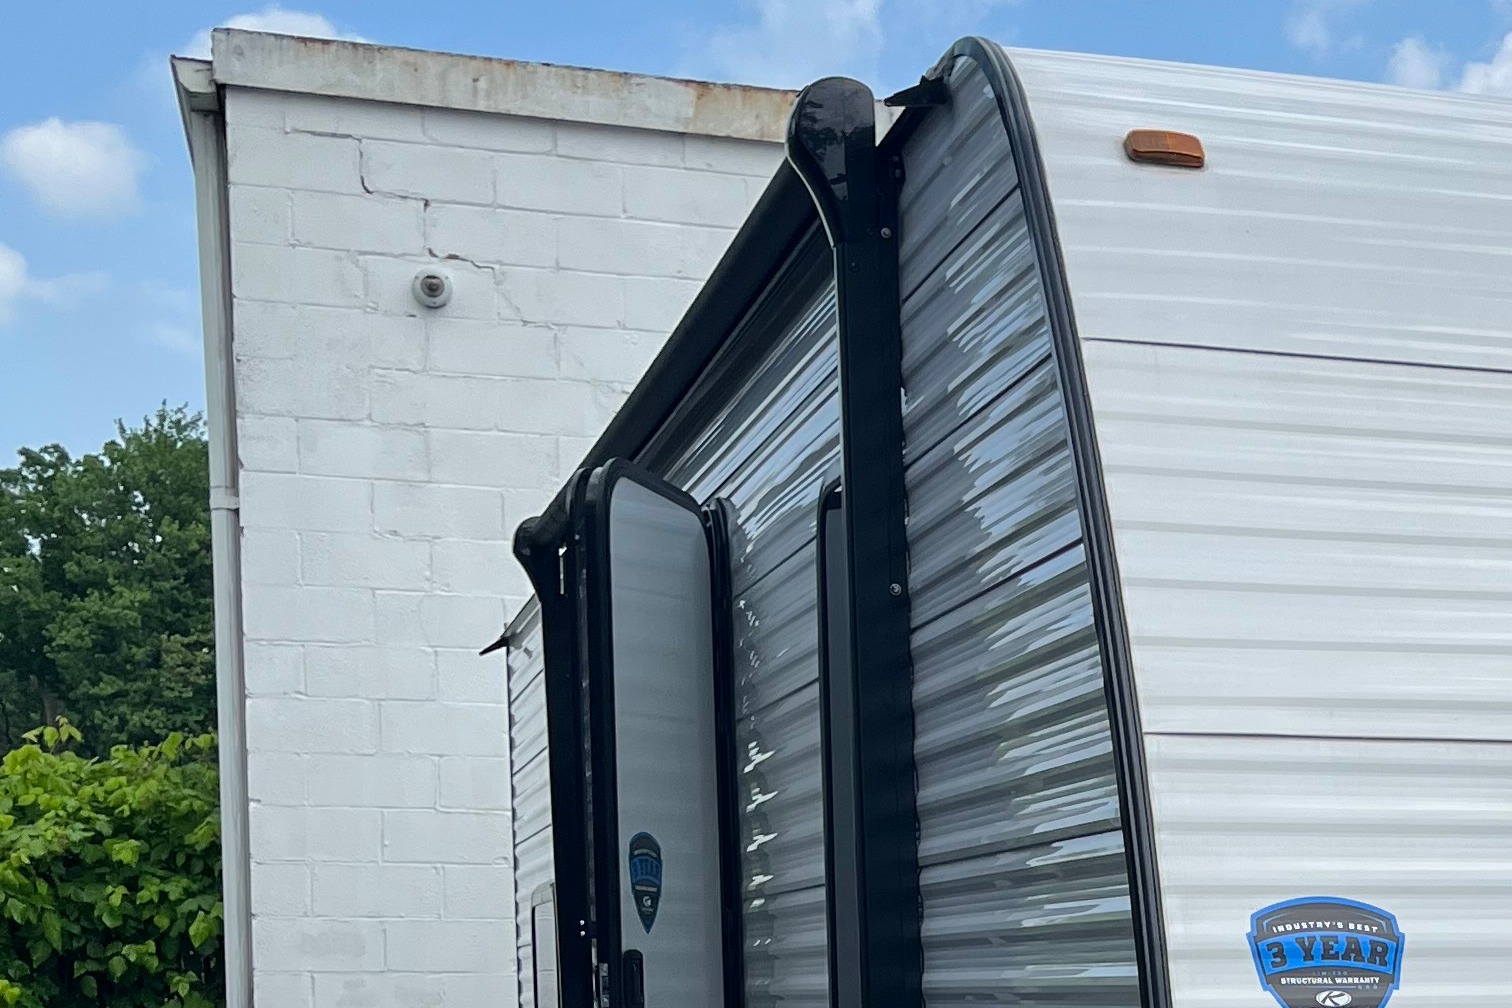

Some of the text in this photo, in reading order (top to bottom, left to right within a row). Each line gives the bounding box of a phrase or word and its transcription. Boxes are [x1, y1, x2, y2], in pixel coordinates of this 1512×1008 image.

[1272, 921, 1379, 933] INDUSTRY'S BEST
[1267, 935, 1389, 968] 3 YEAR
[1280, 976, 1380, 985] STRUCTURAL WARRANTY
